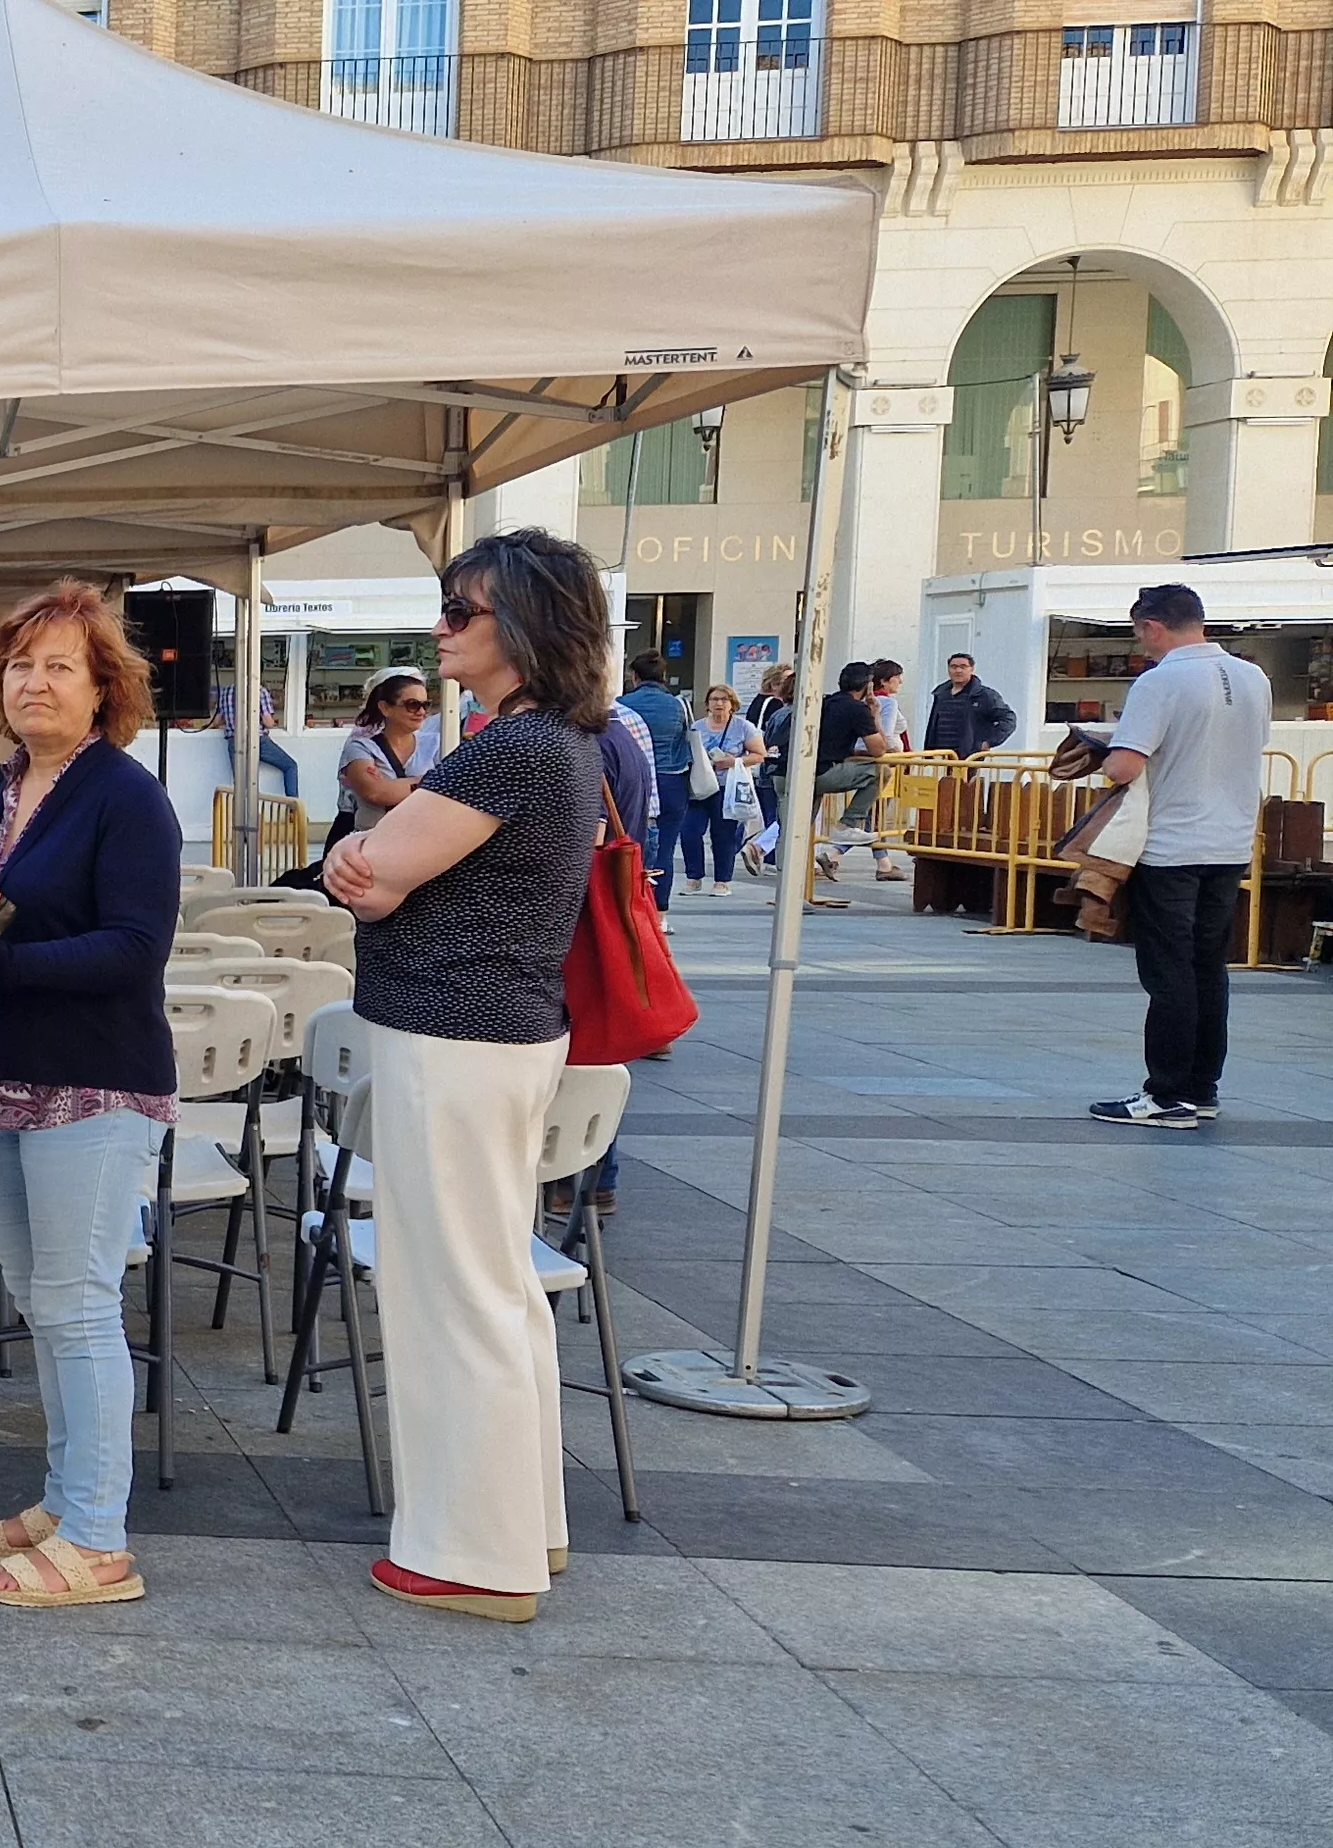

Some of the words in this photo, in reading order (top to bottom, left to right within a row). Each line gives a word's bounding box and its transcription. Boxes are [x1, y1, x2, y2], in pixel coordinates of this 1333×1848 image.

[624, 351, 717, 366] MASTERTENT
[636, 535, 796, 563] OFICIN
[959, 528, 1182, 559] TURISMO
[303, 603, 333, 612] Textos
